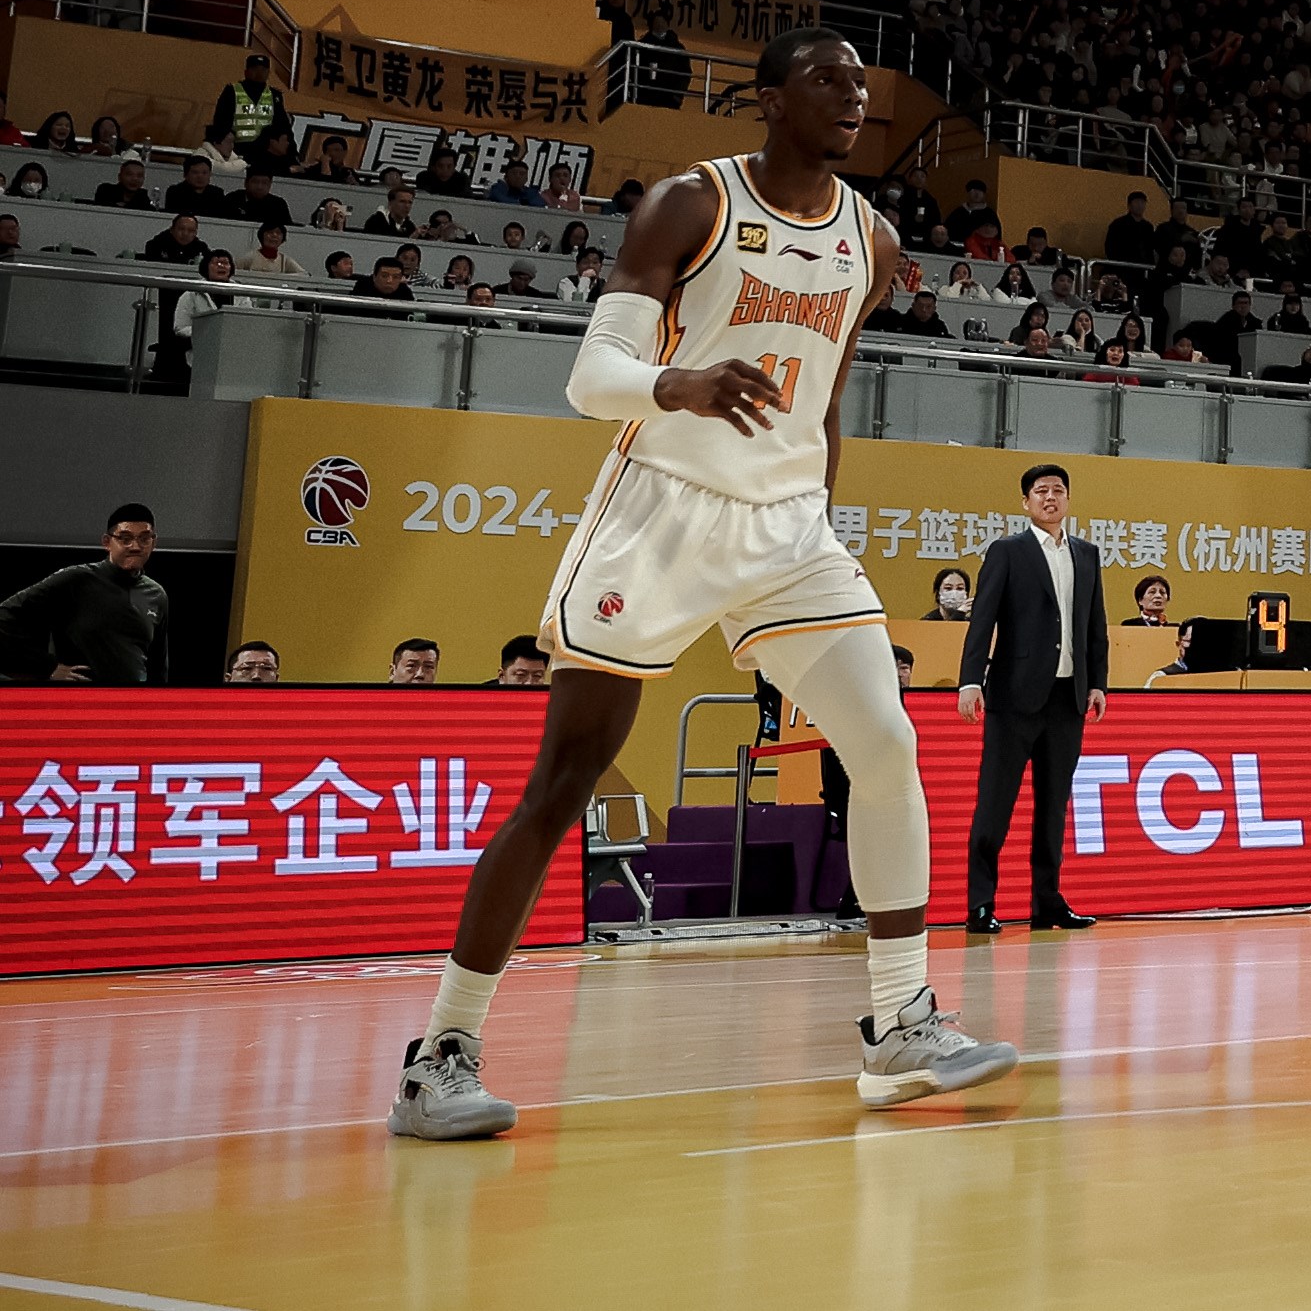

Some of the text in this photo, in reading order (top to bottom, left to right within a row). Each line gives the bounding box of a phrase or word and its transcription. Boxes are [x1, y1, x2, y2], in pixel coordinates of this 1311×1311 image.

[465, 64, 590, 124] 荣辱与共
[728, 267, 854, 345] SHANXI
[750, 352, 803, 415] 11
[304, 526, 361, 548] CBA
[402, 480, 593, 538] 2024-
[1258, 598, 1287, 654] 4
[0, 755, 488, 886] 领军企业
[1071, 749, 1305, 855] TCL
